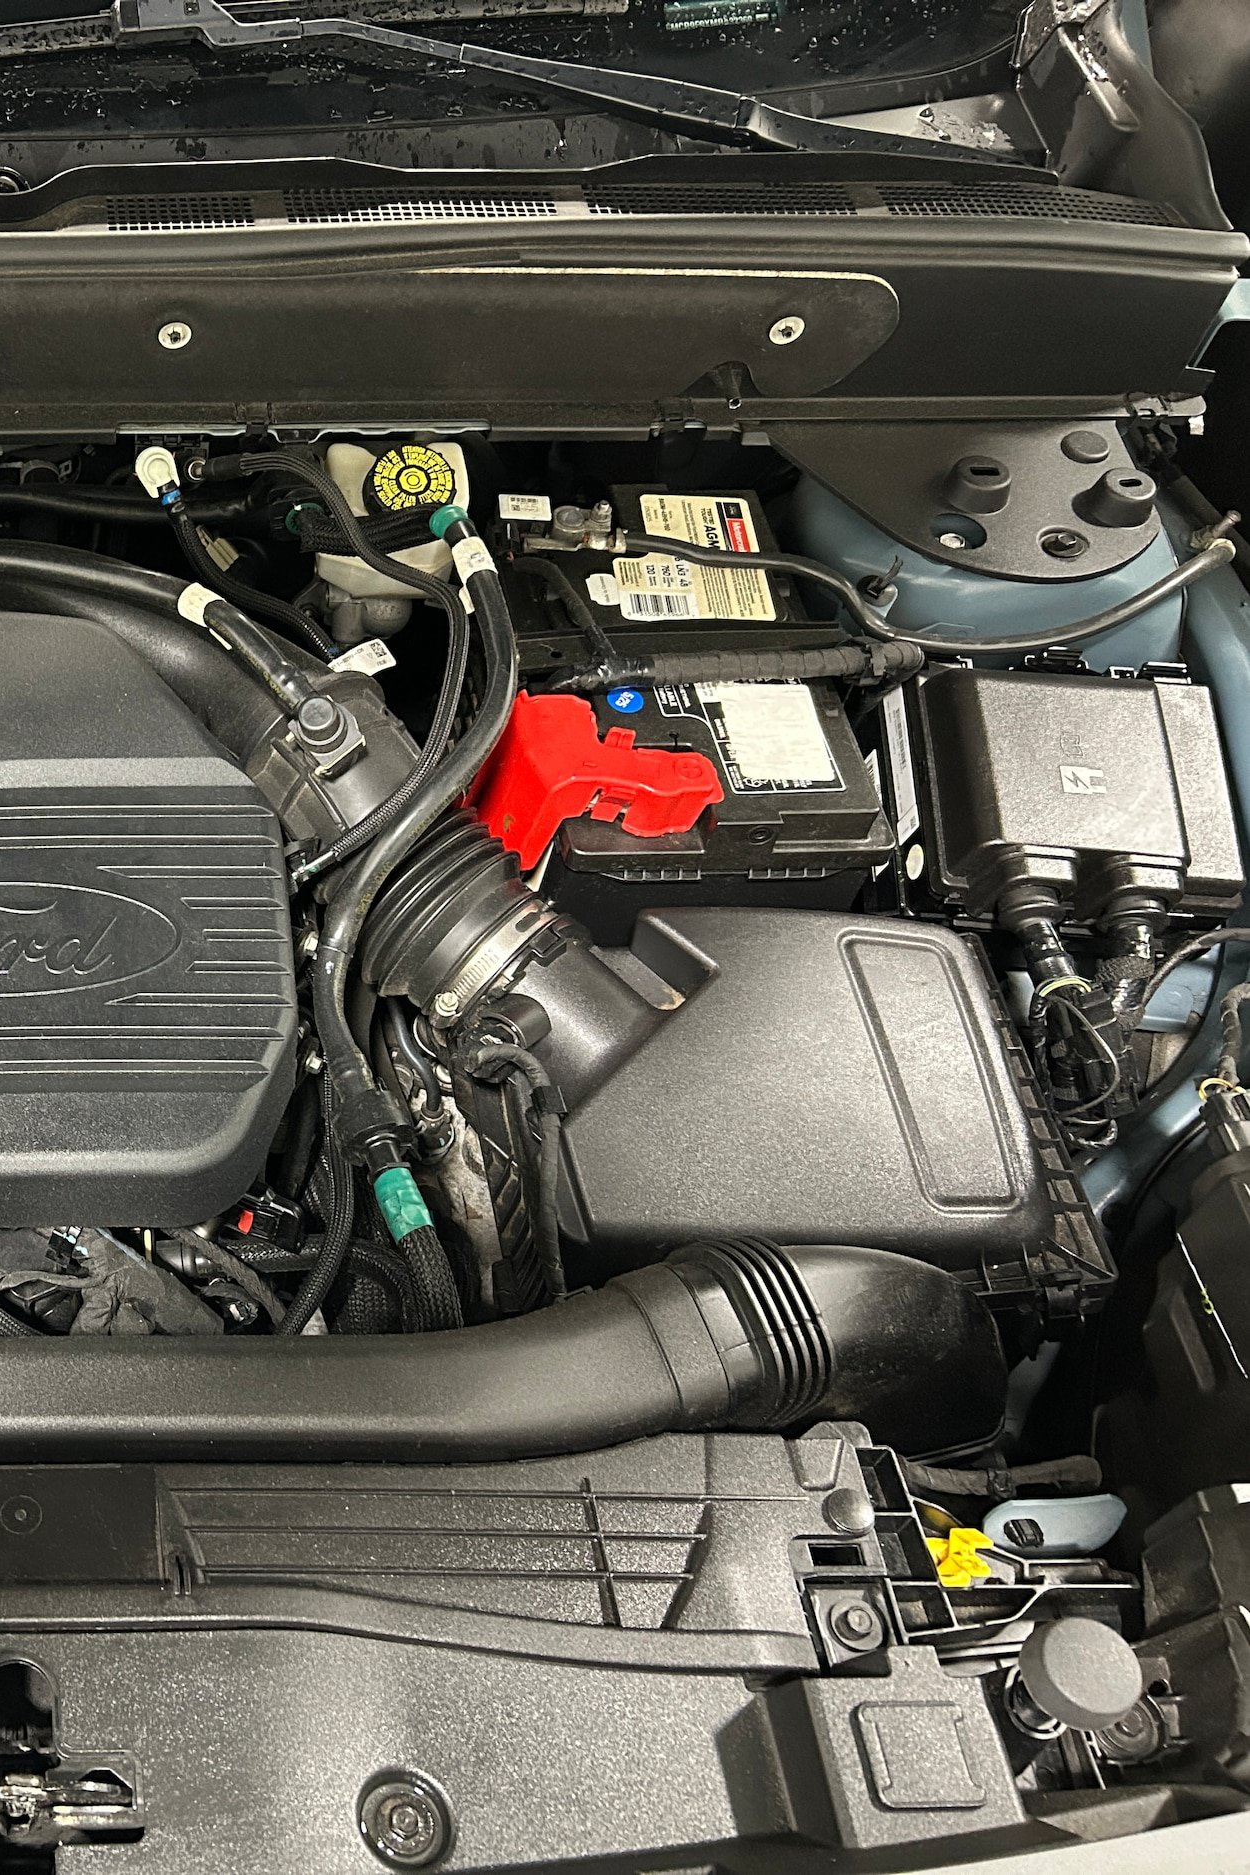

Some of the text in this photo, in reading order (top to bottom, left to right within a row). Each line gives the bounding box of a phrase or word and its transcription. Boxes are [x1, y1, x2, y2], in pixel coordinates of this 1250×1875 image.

[703, 525, 720, 549] AGM
[646, 564, 655, 575] 120
[661, 565, 671, 577] 760
[675, 564, 686, 576] LN3
[615, 690, 635, 709] 5/25
